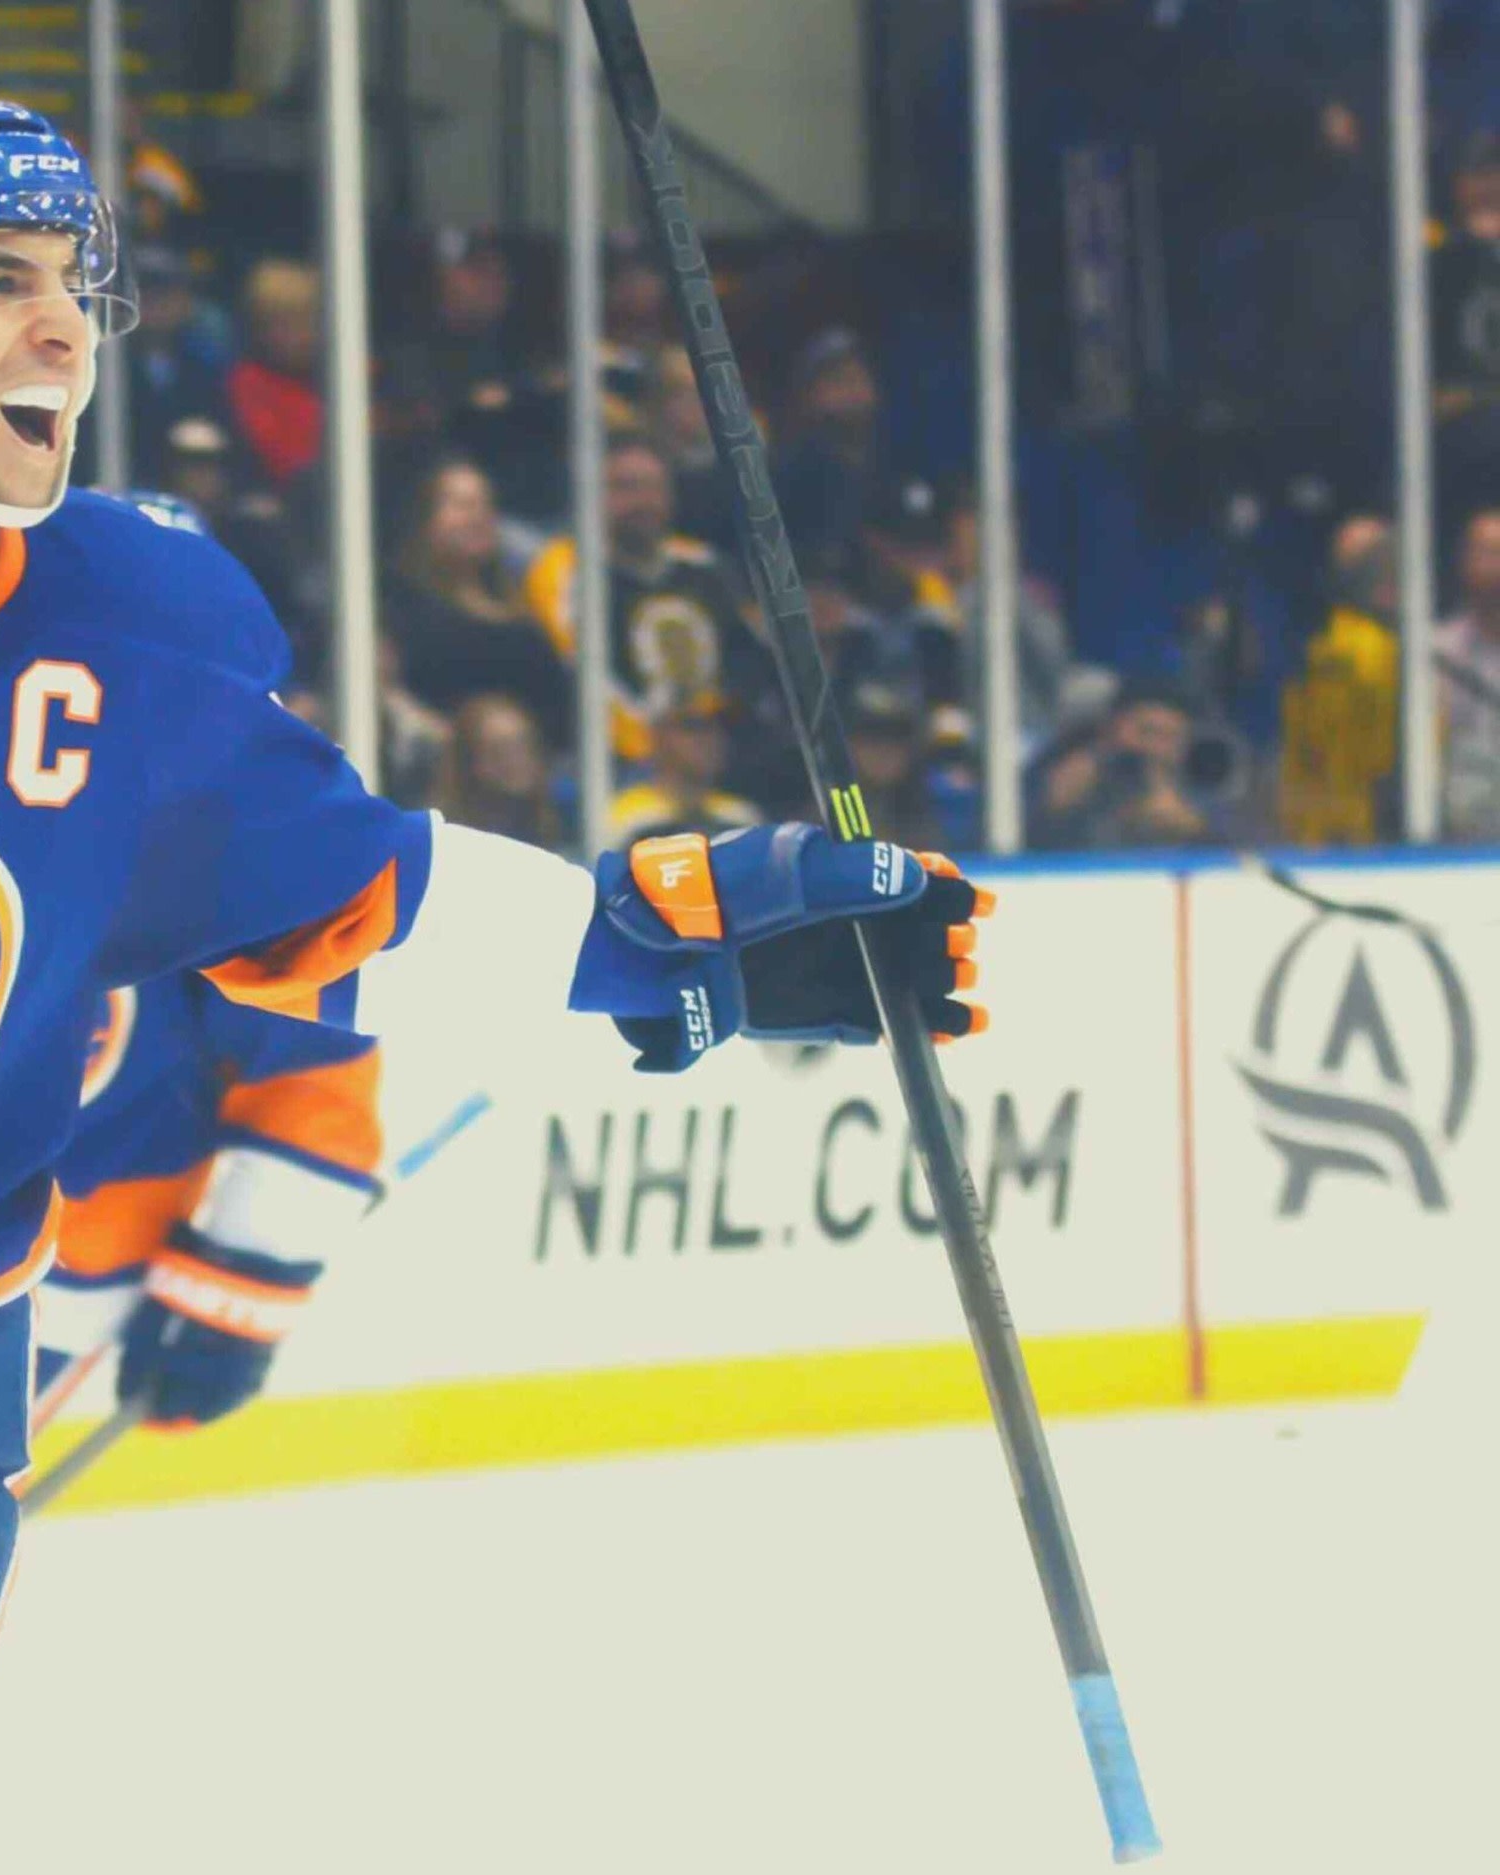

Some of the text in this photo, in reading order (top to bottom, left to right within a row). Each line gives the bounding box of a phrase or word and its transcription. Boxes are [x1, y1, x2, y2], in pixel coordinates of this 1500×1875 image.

[6, 658, 103, 808] C
[680, 988, 706, 1052] CCM
[534, 1088, 1081, 1263] NHL.COM
